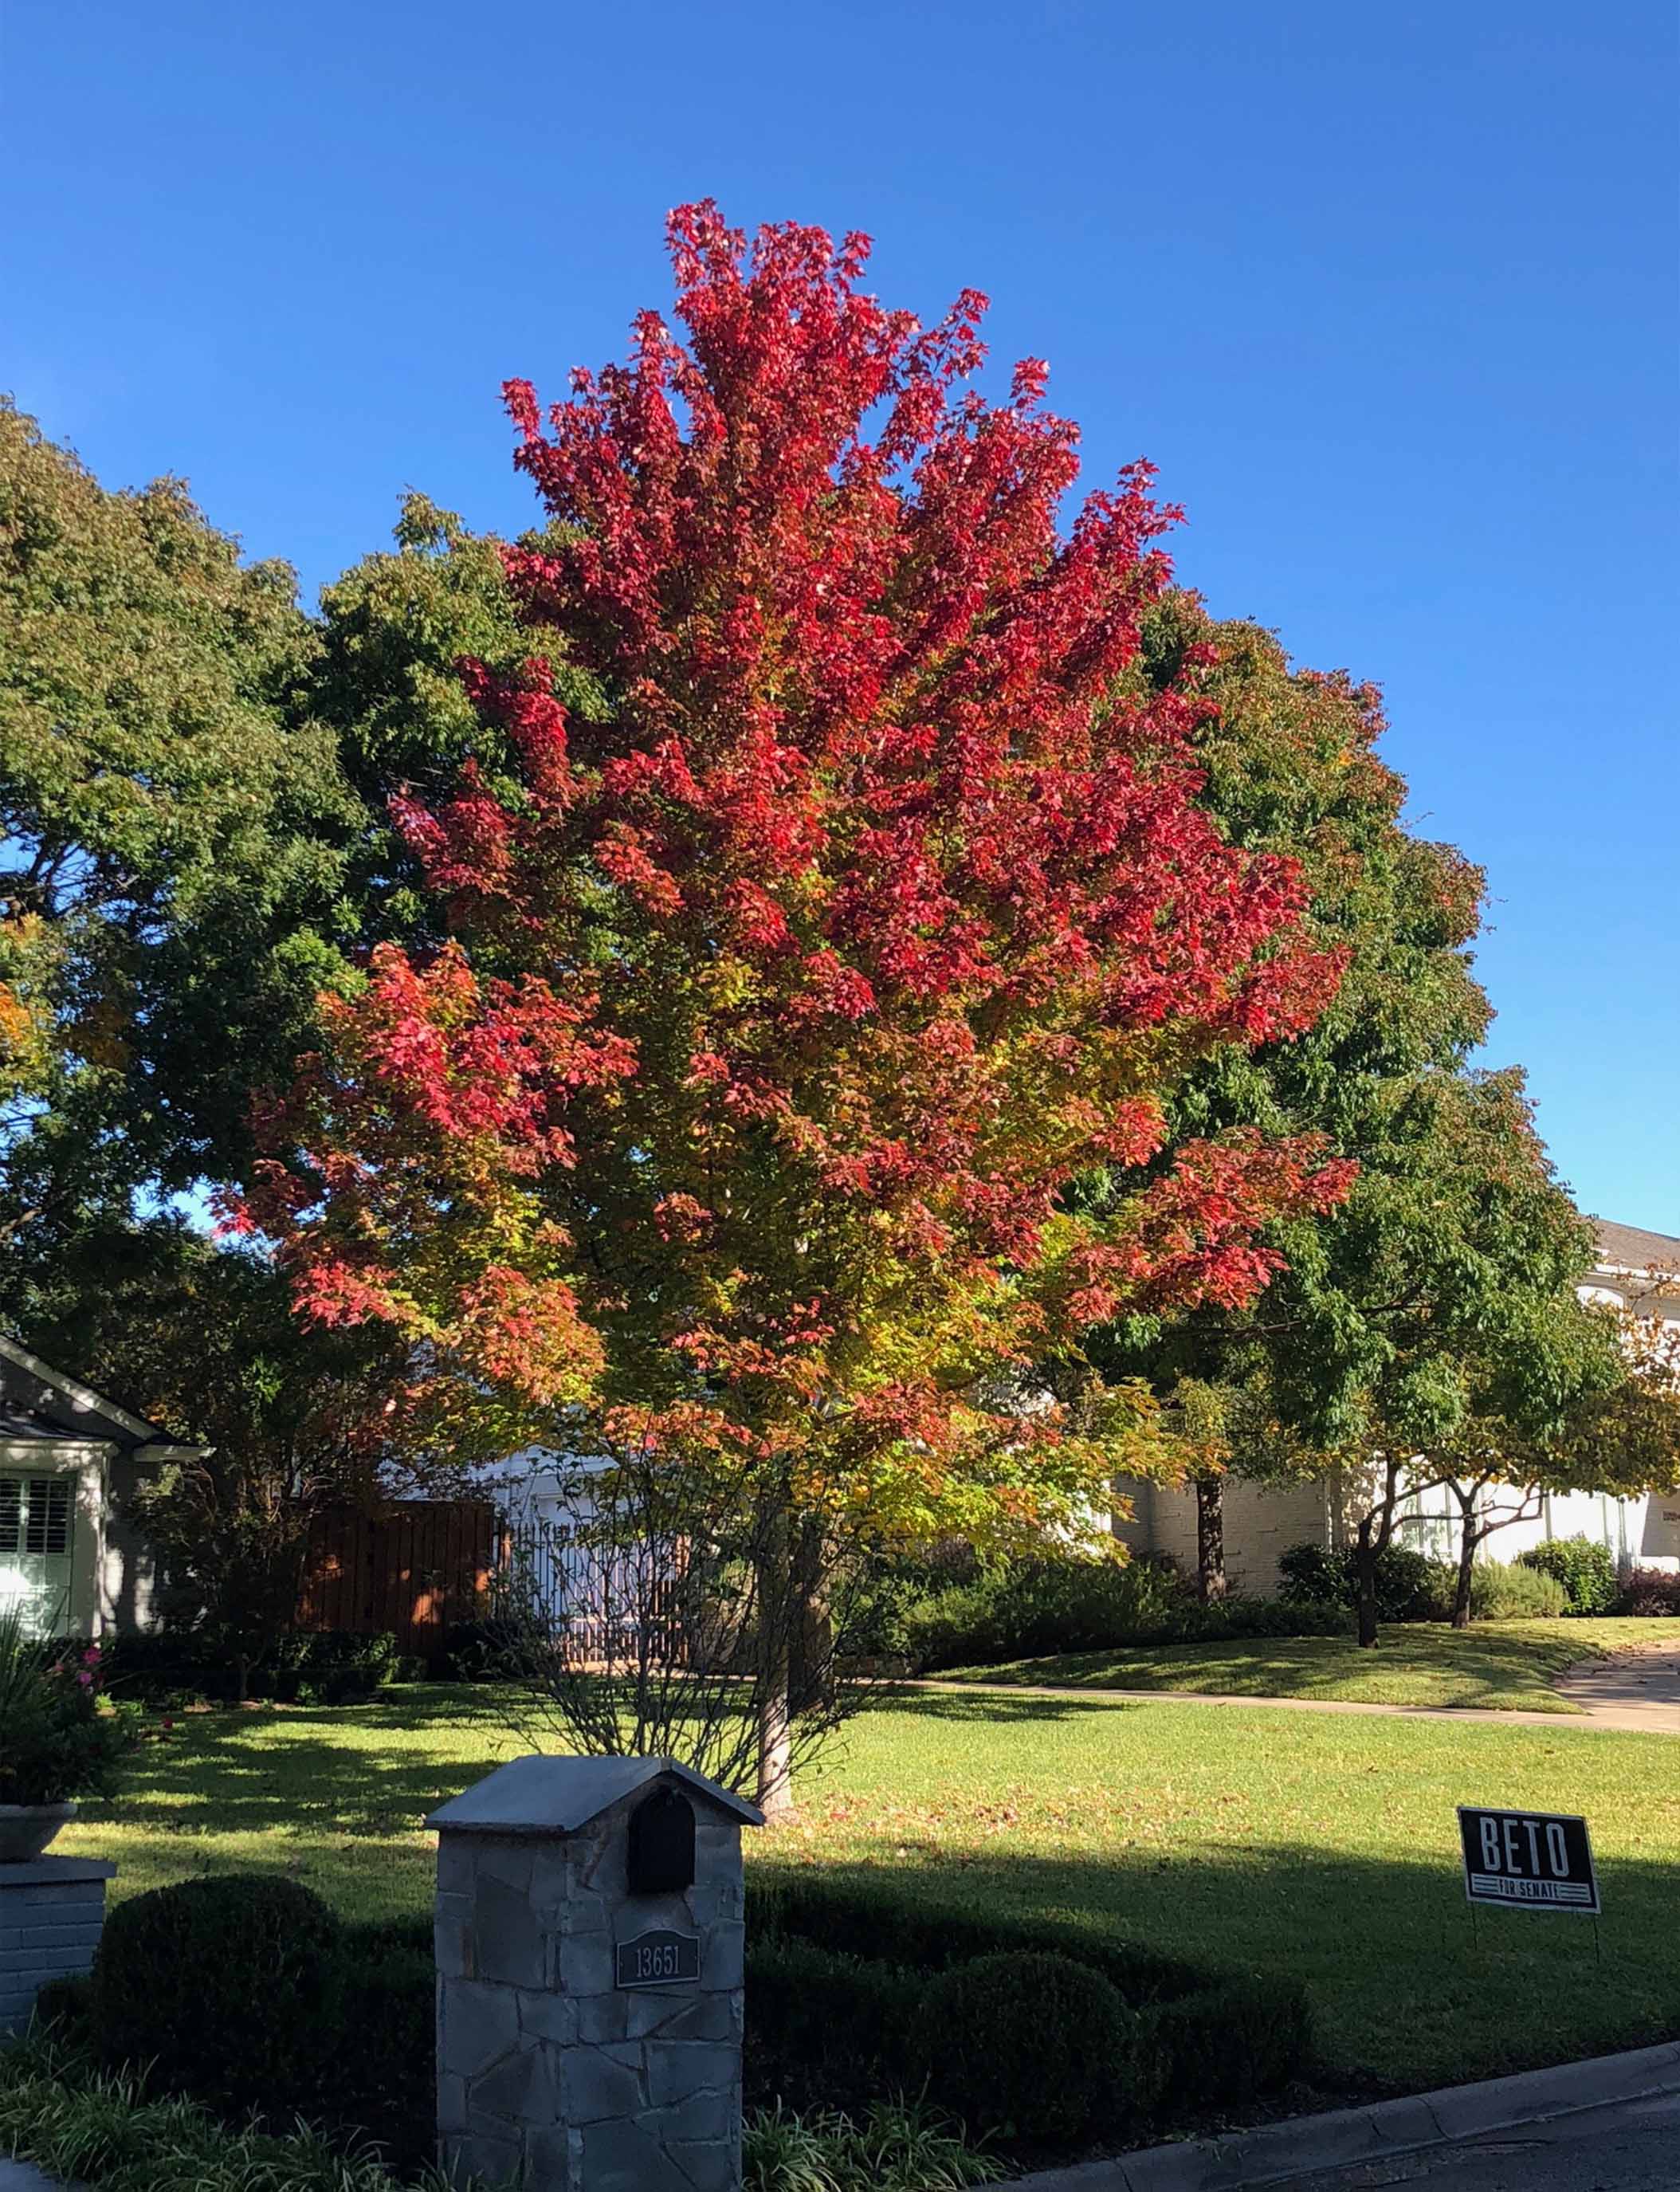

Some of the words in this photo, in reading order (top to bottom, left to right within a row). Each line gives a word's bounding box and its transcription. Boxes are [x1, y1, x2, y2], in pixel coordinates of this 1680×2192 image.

[1479, 1817, 1570, 1877] BETO
[1519, 1881, 1559, 1899] SENATE
[637, 1945, 679, 1977] 13651
